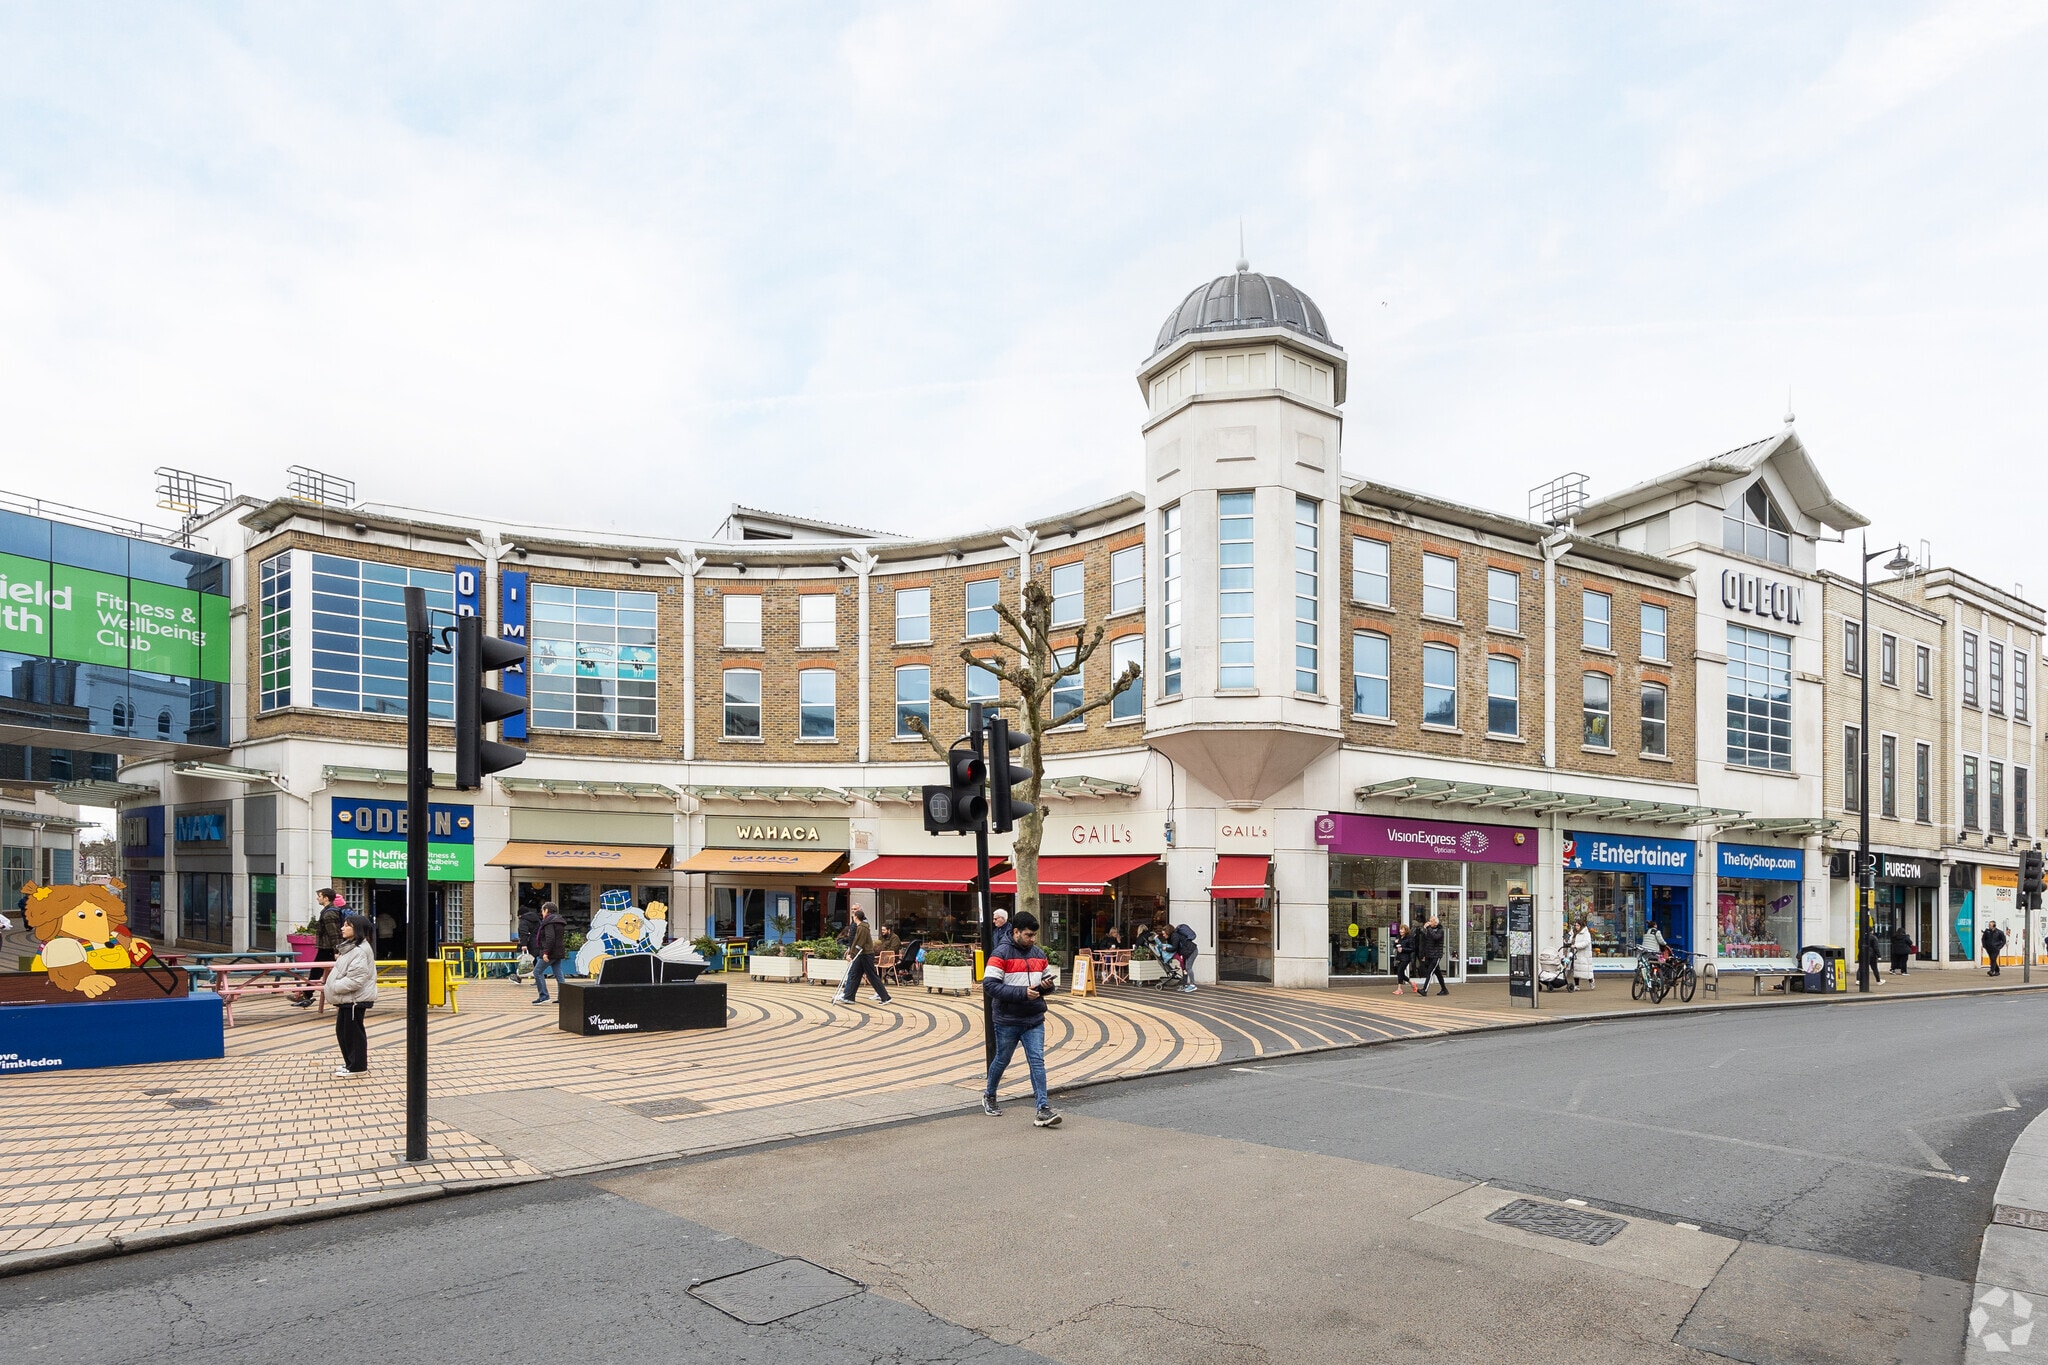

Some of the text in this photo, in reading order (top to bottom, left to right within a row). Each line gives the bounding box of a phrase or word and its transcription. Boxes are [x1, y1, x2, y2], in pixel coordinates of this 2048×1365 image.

[1722, 569, 1804, 625] ODEON
[96, 591, 196, 624] Fitness &
[96, 610, 207, 646] Wellbeing
[96, 630, 151, 651] Club
[355, 807, 451, 835] ODEN
[736, 825, 820, 841] WAHACA
[1072, 823, 1133, 845] GAIL's
[1221, 825, 1268, 837] GAIL's
[1387, 828, 1456, 846] VisionExpress
[373, 850, 408, 860] Nuffie
[1433, 846, 1456, 854] Opticians
[1591, 842, 1599, 861] The
[1600, 842, 1687, 867] Entertainer
[1723, 852, 1796, 871] TheToyShop.com
[1884, 861, 1920, 878] PUREGYM
[598, 1022, 638, 1030] Wimbledon
[0, 1057, 63, 1069] imbledon
